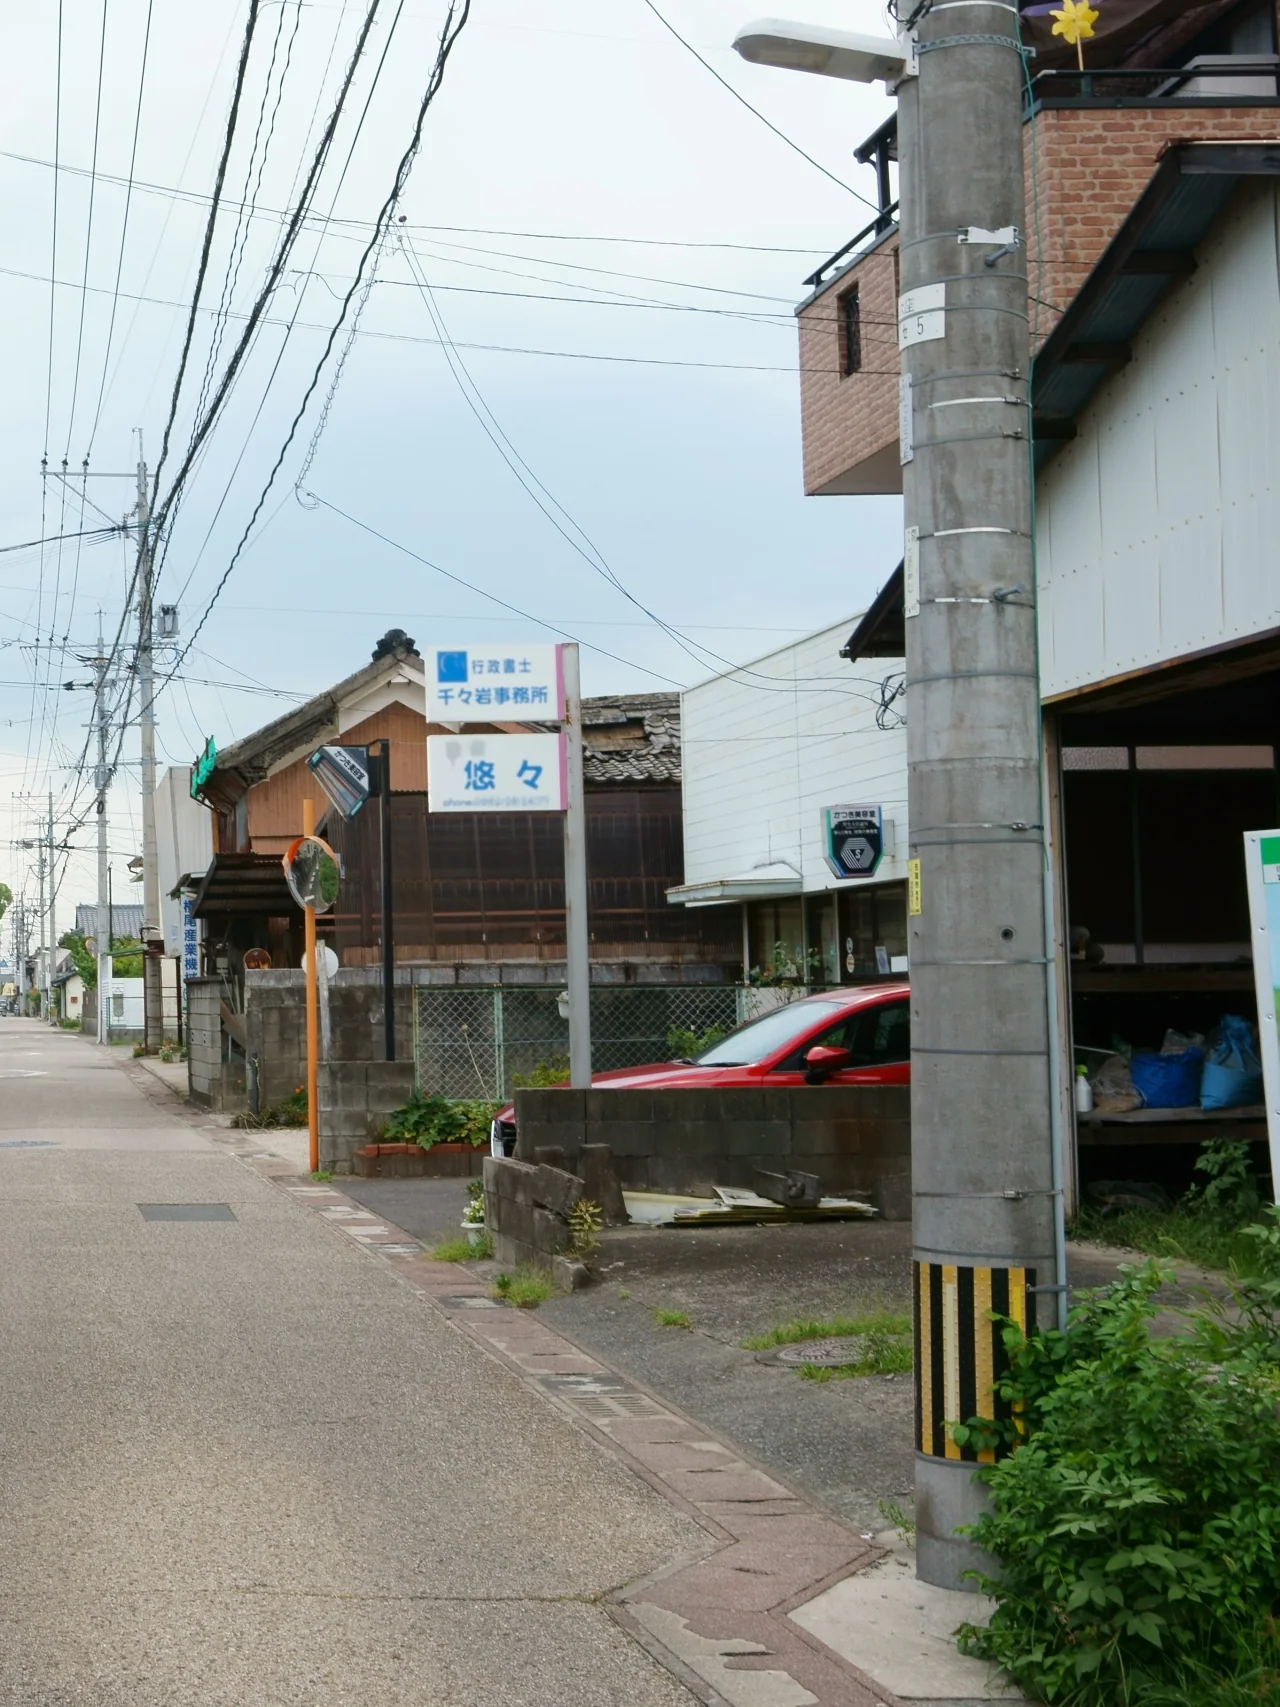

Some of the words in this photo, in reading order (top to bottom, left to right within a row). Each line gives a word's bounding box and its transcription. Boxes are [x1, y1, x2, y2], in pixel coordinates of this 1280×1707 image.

[471, 657, 532, 675] 行政書士
[437, 685, 548, 705] 千々岩事務所
[463, 759, 544, 791] 悠々
[855, 849, 861, 860] S
